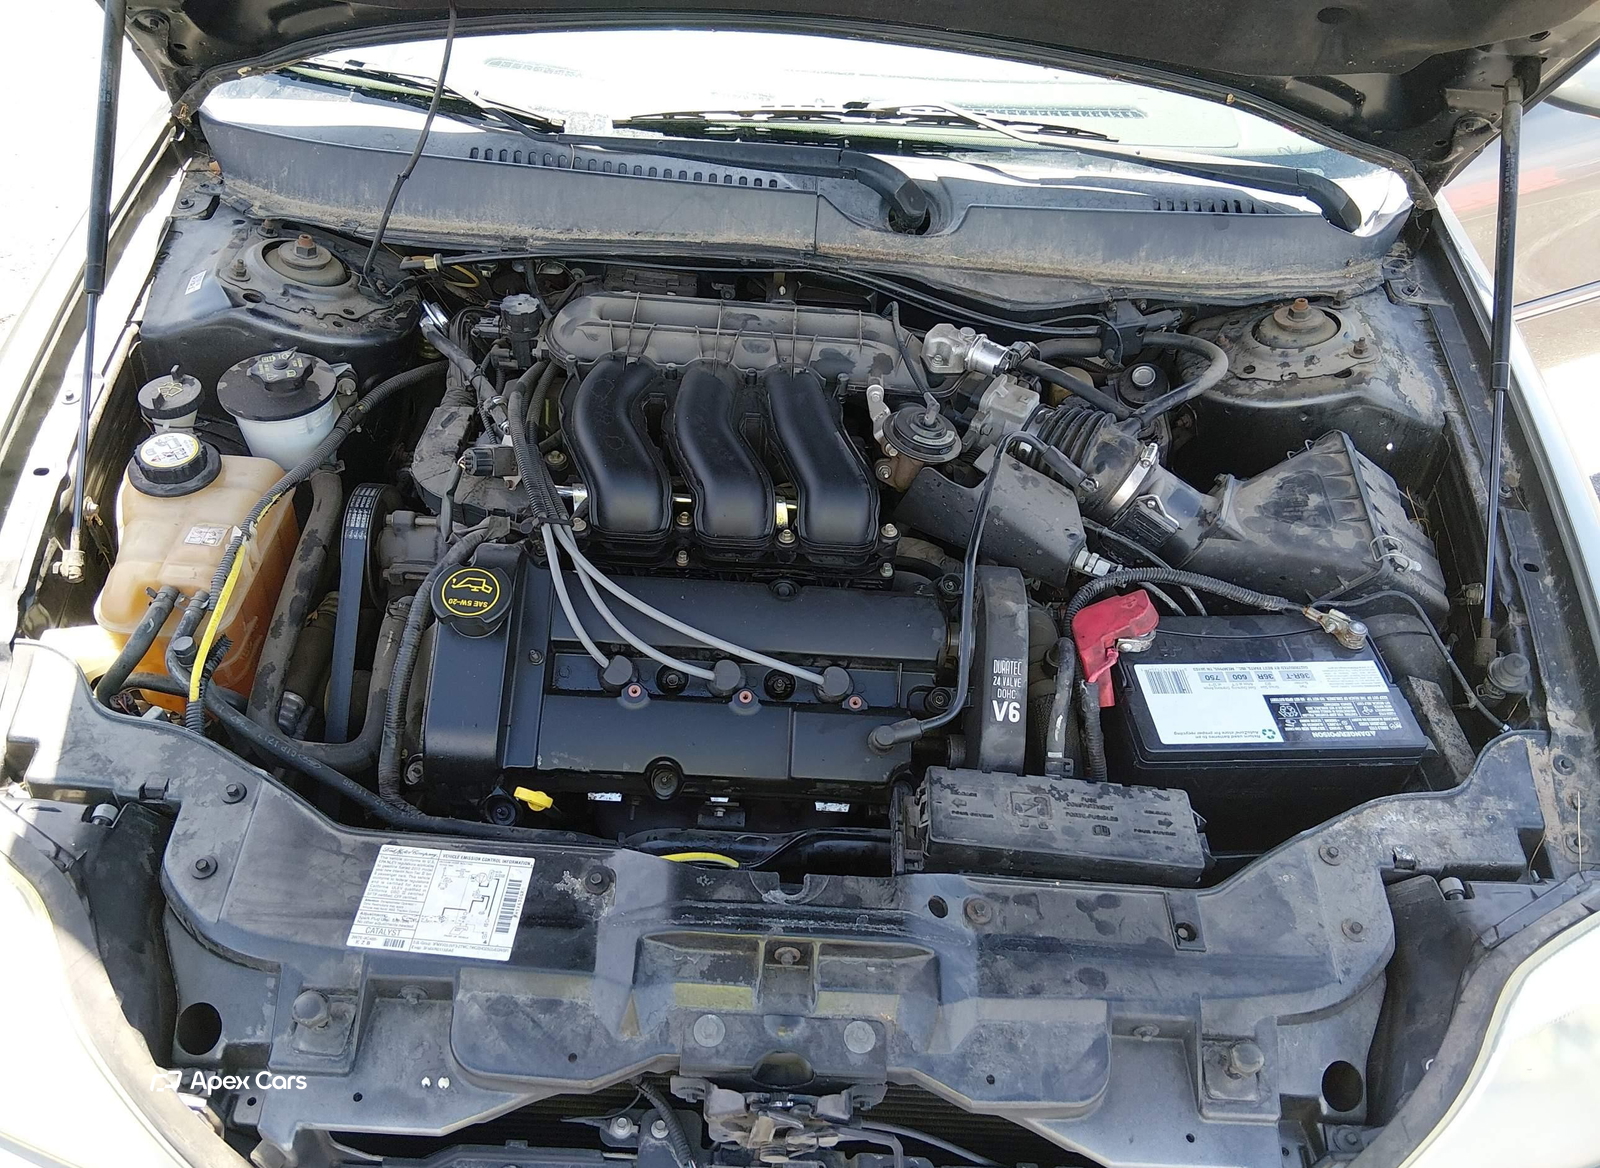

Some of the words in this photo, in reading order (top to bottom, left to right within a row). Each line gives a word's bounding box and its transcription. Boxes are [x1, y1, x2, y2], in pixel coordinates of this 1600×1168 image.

[448, 598, 472, 606] 5W-20
[994, 660, 1022, 675] DURATEC
[993, 676, 1000, 686] 24
[1003, 677, 1021, 687] VALVE
[998, 689, 1016, 699] DOHC
[992, 700, 1020, 722] V6
[365, 926, 402, 937] CATALYST
